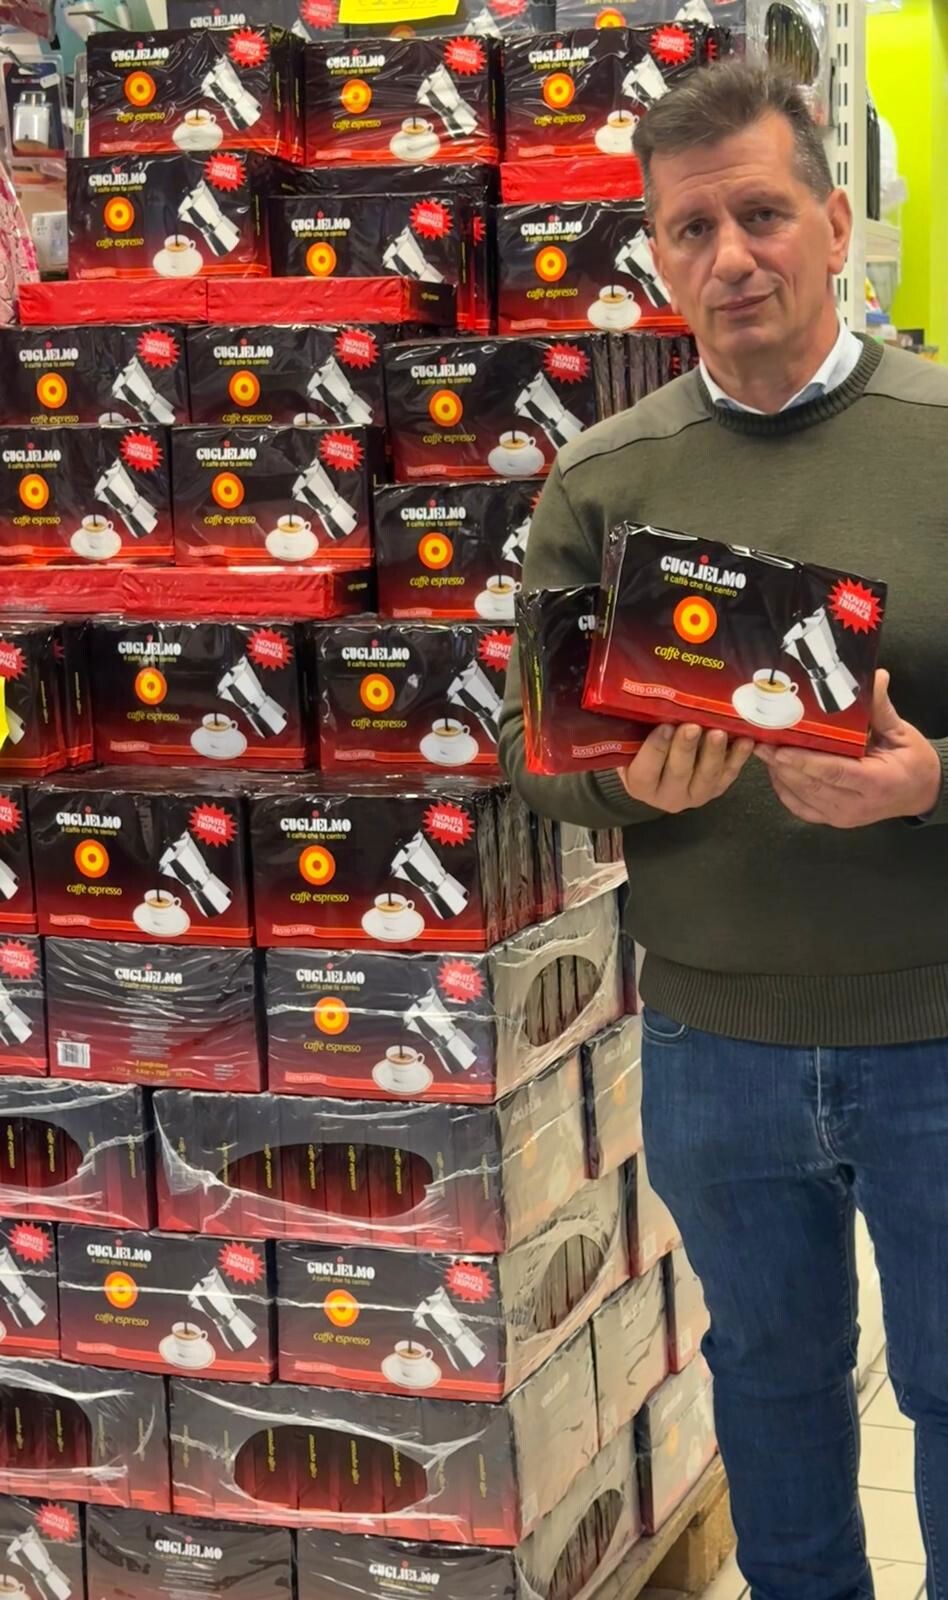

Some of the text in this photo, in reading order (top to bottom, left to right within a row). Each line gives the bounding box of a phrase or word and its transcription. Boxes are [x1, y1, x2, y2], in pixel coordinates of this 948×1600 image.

[111, 41, 170, 61] GUGLIELMO
[326, 48, 386, 68] GUGLIELMO
[528, 43, 590, 63] GUGLIELMO
[135, 112, 165, 122] espresso
[351, 120, 381, 130] espresso
[553, 114, 586, 125] espresso
[88, 166, 147, 186] GUGLIELMO
[291, 211, 351, 231] GUGLIELMO
[521, 215, 583, 235] GUGLIELMO
[114, 238, 144, 248] espresso
[546, 288, 577, 299] espresso
[19, 341, 79, 361] GUGLIELMO
[213, 338, 274, 358] GUGLIELMO
[410, 357, 476, 377] GUGLIELMO
[50, 416, 79, 424] espresso
[242, 414, 272, 424] espresso
[444, 434, 476, 444] espresso
[2, 443, 61, 462] GUGLIELMO
[196, 440, 257, 460] GUGLIELMO
[400, 499, 466, 520] GUGLIELMO
[32, 516, 60, 526] espresso
[224, 516, 256, 526] espresso
[660, 555, 747, 589] GUGLIELMO
[431, 577, 465, 587] espresso
[670, 575, 688, 586] caffè
[689, 580, 703, 589] che
[713, 586, 737, 598] centro
[118, 634, 182, 655] GUGLIELMO
[341, 639, 410, 660] GUGLIELMO
[682, 652, 724, 669] espresso
[623, 681, 675, 698] GUSTO CLASSICO
[147, 712, 179, 722] espresso
[372, 720, 407, 729] espresso
[573, 742, 622, 756] GUSTO CLASSICO
[56, 806, 122, 829] GUGLIELMO
[280, 810, 351, 832] GUGLIELMO
[88, 886, 122, 896] espresso
[313, 894, 349, 904] espresso
[296, 962, 365, 984] GUGLIELMO
[326, 1043, 361, 1053] espresso
[86, 1239, 152, 1261] GUGLIELMO
[307, 1256, 375, 1279] GUGLIELMO
[115, 1316, 149, 1326] espresso
[336, 1335, 370, 1345] espresso
[155, 1536, 223, 1560] GUGLIELMO
